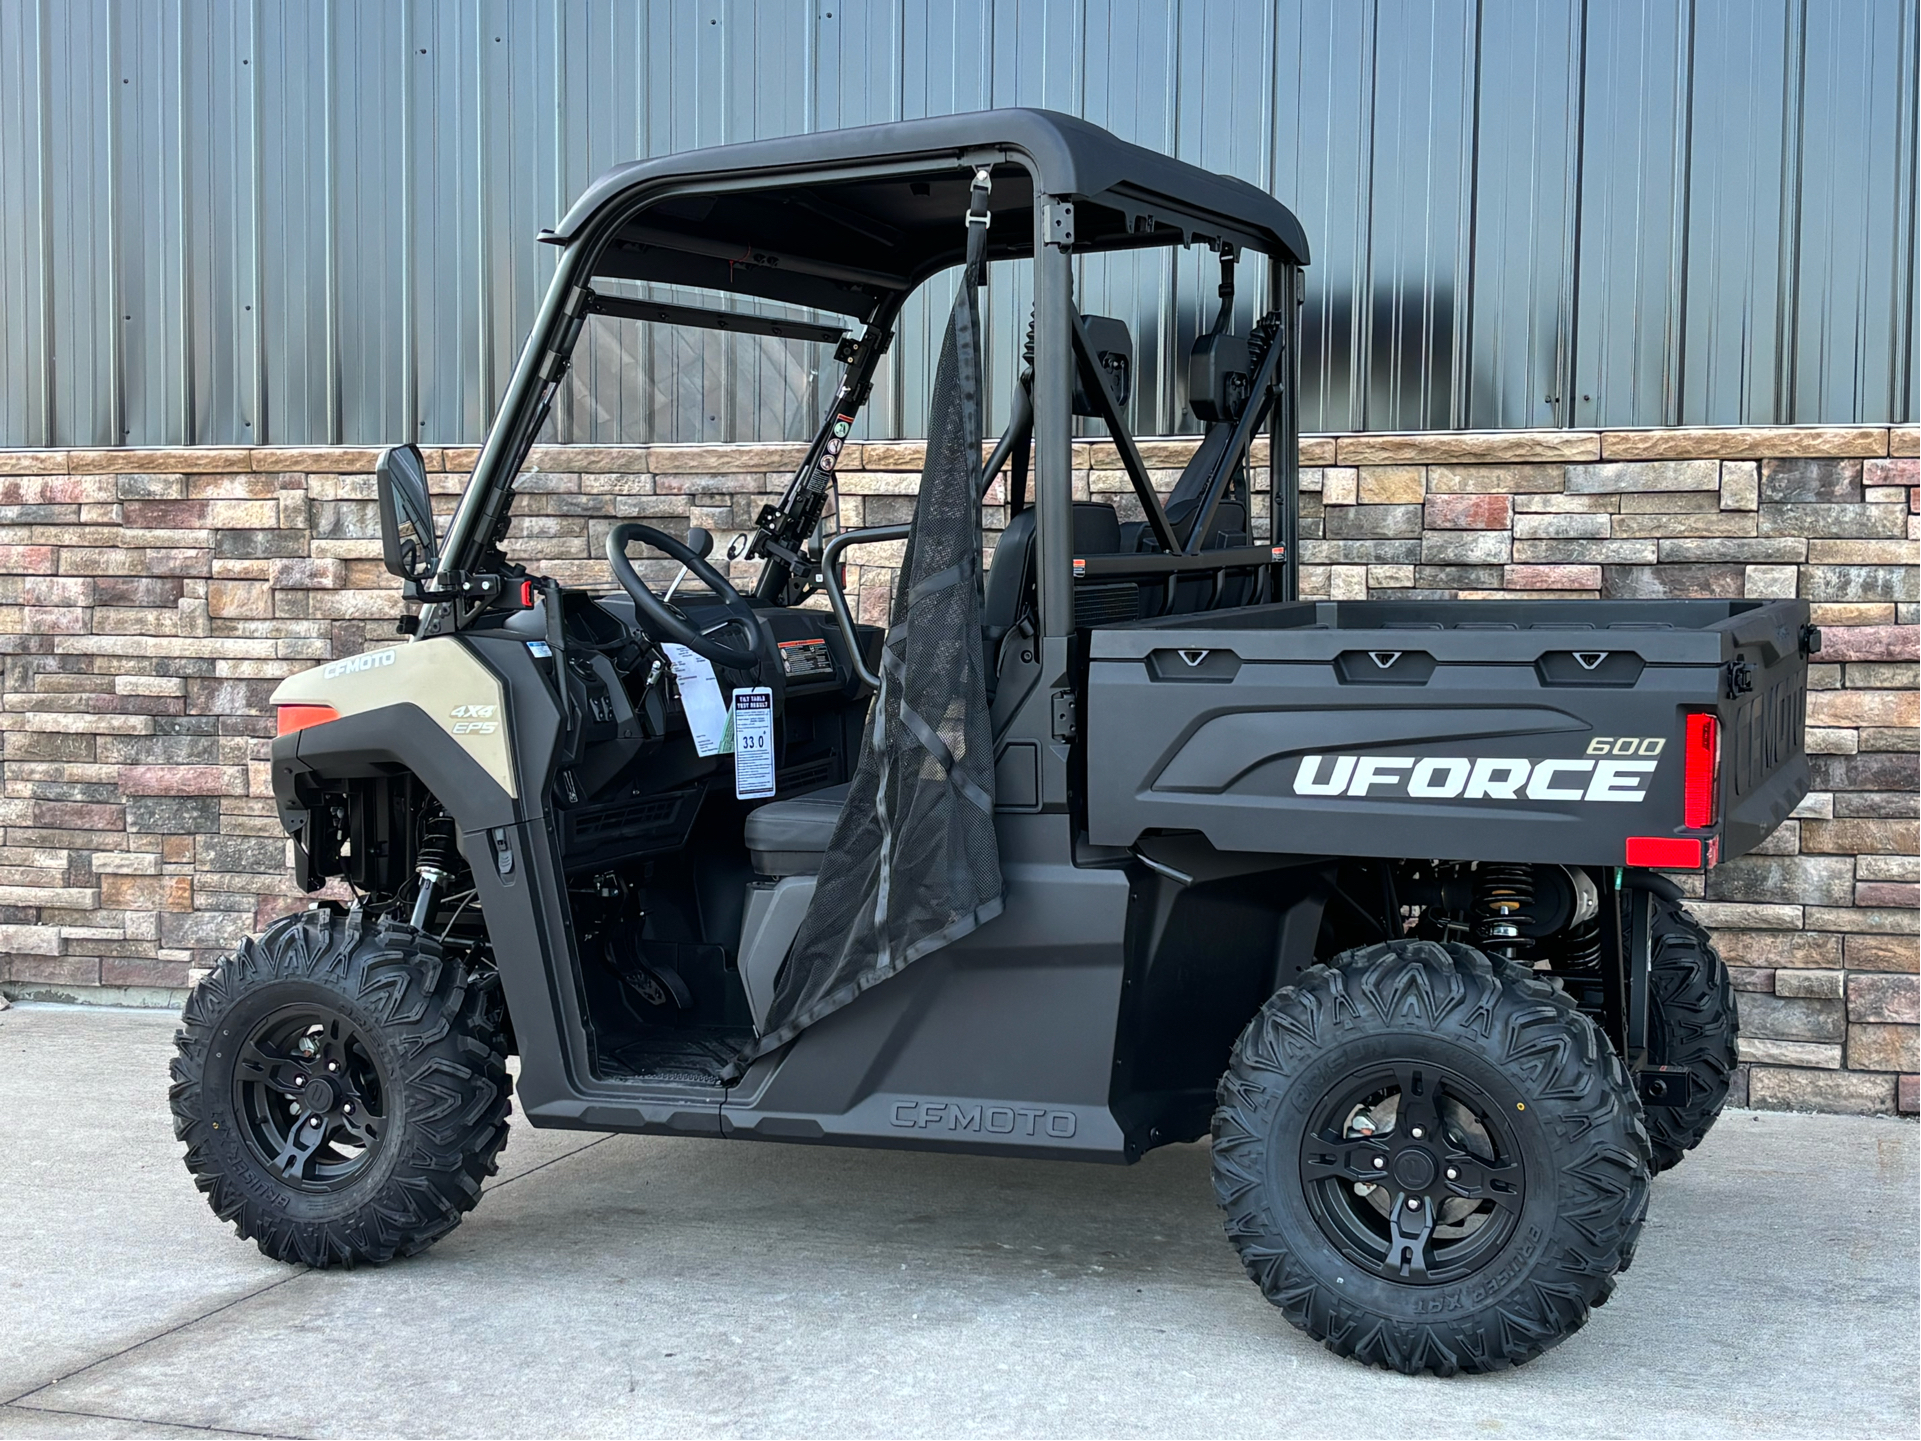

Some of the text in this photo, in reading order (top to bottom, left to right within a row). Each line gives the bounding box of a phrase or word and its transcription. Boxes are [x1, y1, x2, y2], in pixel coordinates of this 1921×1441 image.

[323, 650, 396, 680] CFMOTO
[450, 704, 498, 718] 4X4
[452, 721, 499, 734] EPS
[1585, 737, 1667, 756] 600
[1292, 755, 1659, 802] UFORCE
[889, 1100, 1078, 1139] CFMOTO
